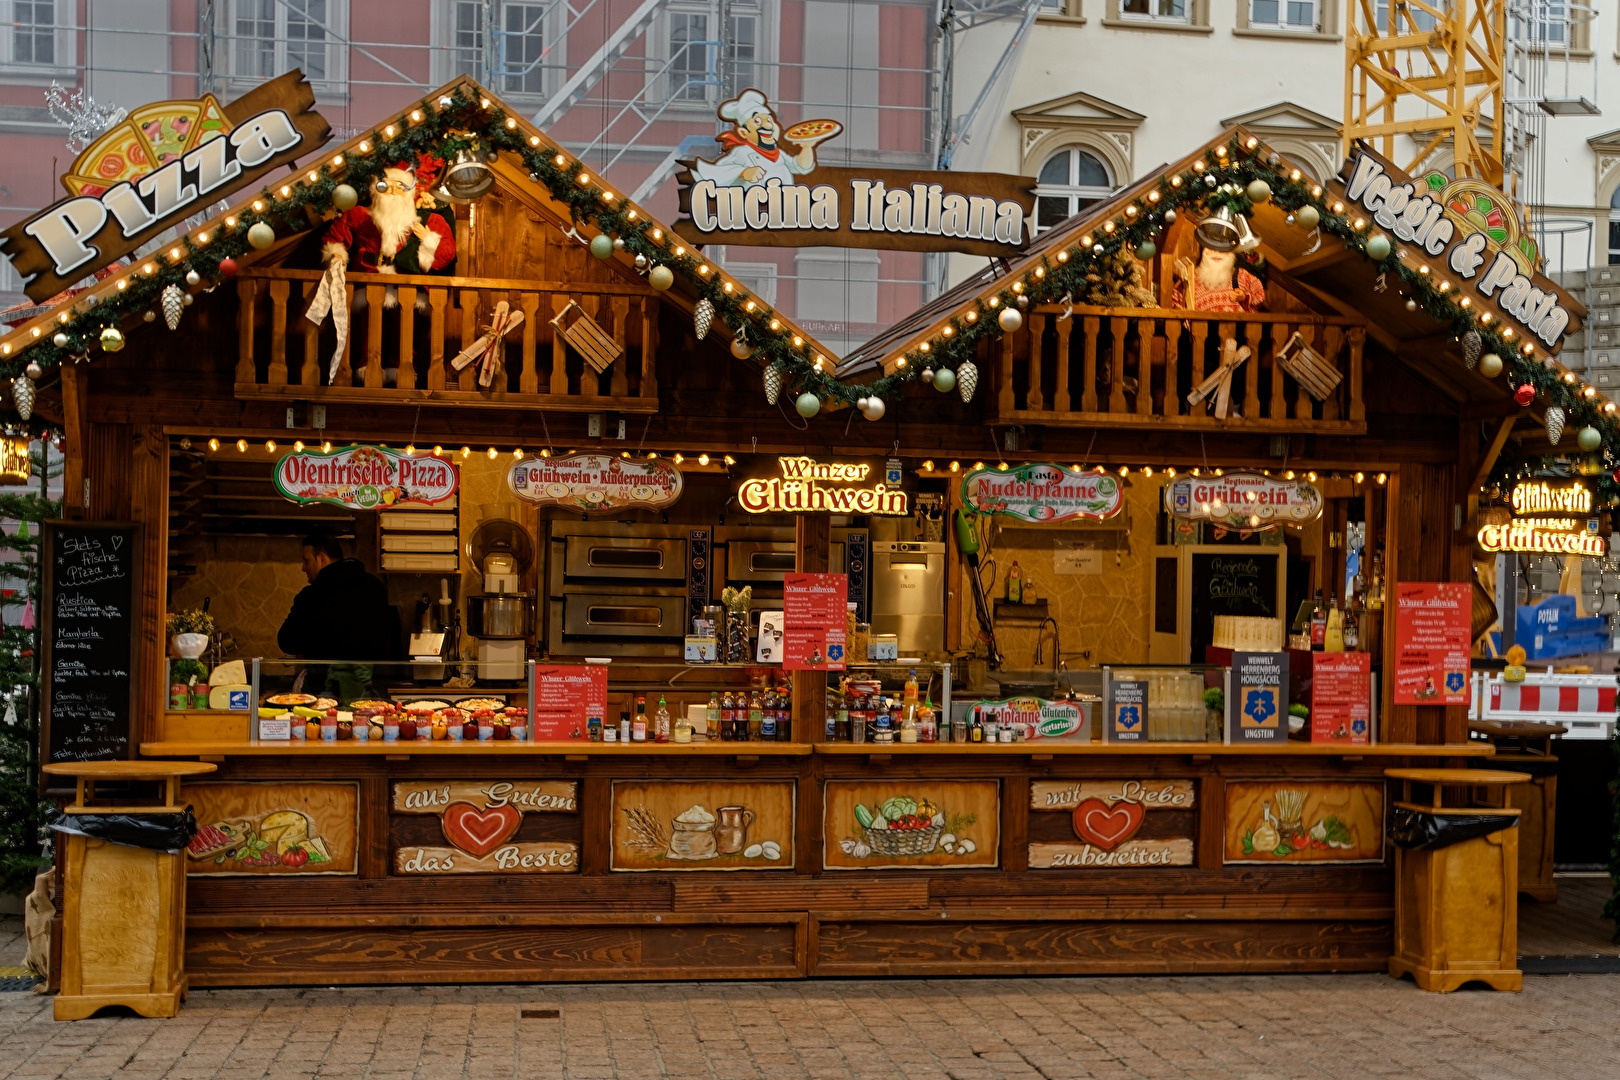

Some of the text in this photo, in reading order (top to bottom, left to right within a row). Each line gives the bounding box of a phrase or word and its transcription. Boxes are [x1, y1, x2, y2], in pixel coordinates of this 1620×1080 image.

[336, 128, 362, 136] Burk
[23, 109, 303, 276] Pizza
[690, 177, 1026, 246] Cucina Italiana
[1347, 154, 1570, 347] Veggie & Pasta
[284, 456, 448, 487] Ofenfrische Pizza
[545, 460, 582, 469] Regionaler
[779, 457, 870, 481] Winzer
[529, 468, 591, 485] Glühwein
[600, 469, 669, 491] Kinderpunsch
[1027, 471, 1059, 480] Pasta
[1224, 477, 1266, 487] Regionaler
[341, 489, 378, 503] auch VEGAN
[739, 479, 908, 514] Glühwein
[978, 479, 1097, 500] Nudelpfanne
[1194, 485, 1289, 505] Glühwein
[1512, 480, 1592, 515] Glühwein
[63, 536, 101, 555] Stets
[1478, 524, 1605, 557] Glühwein
[81, 548, 120, 566] frische
[67, 566, 103, 580] Pizza
[809, 586, 837, 594] Glühwein
[1209, 576, 1258, 598] Glühwein
[57, 591, 97, 606] Rustica
[1399, 598, 1458, 608] Winzer Glühwein
[1537, 608, 1559, 624] POTAIN
[58, 627, 104, 640] Margherita
[1247, 656, 1274, 665] WEINWELT
[1241, 665, 1280, 675] HERRENBERG
[1336, 664, 1360, 672] Glühwein
[564, 675, 592, 683] Glühwein
[1241, 674, 1280, 685] HONIGSÄCKEL
[1115, 689, 1143, 697] HERRENBERG
[1041, 707, 1079, 719] Glutenfrei
[80, 724, 92, 734] je
[1118, 732, 1139, 740] UNGSTEIN
[1244, 729, 1274, 739] UNGSTEIN
[64, 736, 73, 745] je
[404, 782, 573, 811] aus Gutem
[1046, 780, 1186, 806] mit Liebe
[404, 845, 574, 873] das Beste
[1050, 843, 1173, 867] zubereitet
